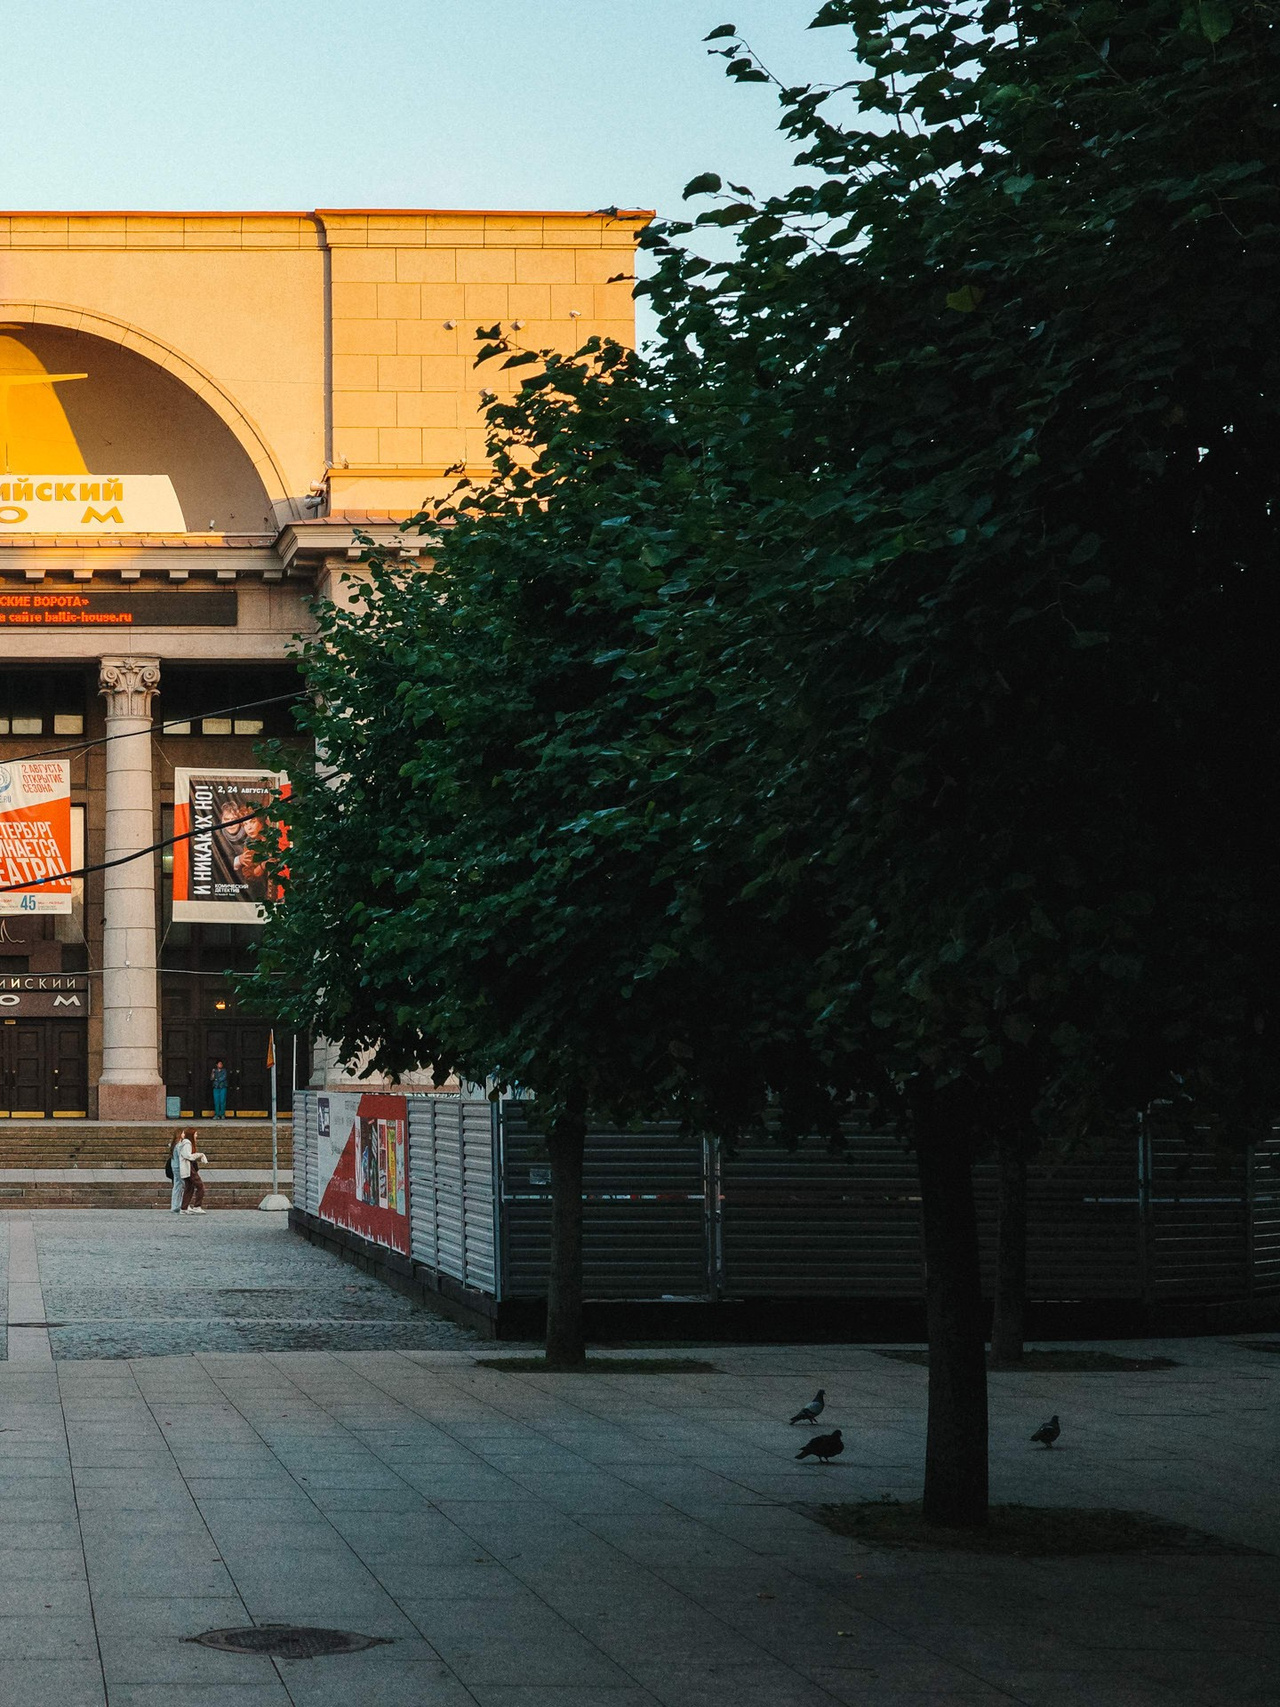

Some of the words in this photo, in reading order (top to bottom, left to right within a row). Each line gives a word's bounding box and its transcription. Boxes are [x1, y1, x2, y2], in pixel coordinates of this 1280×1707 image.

[33, 595, 90, 607] ВОРОТА»
[8, 611, 42, 622] сайте
[21, 764, 29, 773] 2
[29, 764, 64, 773] АВГУСТА
[22, 774, 65, 783] ОТКРЫТИЕ
[22, 784, 54, 793] СЕЗОНА
[227, 785, 238, 794] 24
[194, 785, 214, 810] НО!
[20, 894, 36, 911] 45
